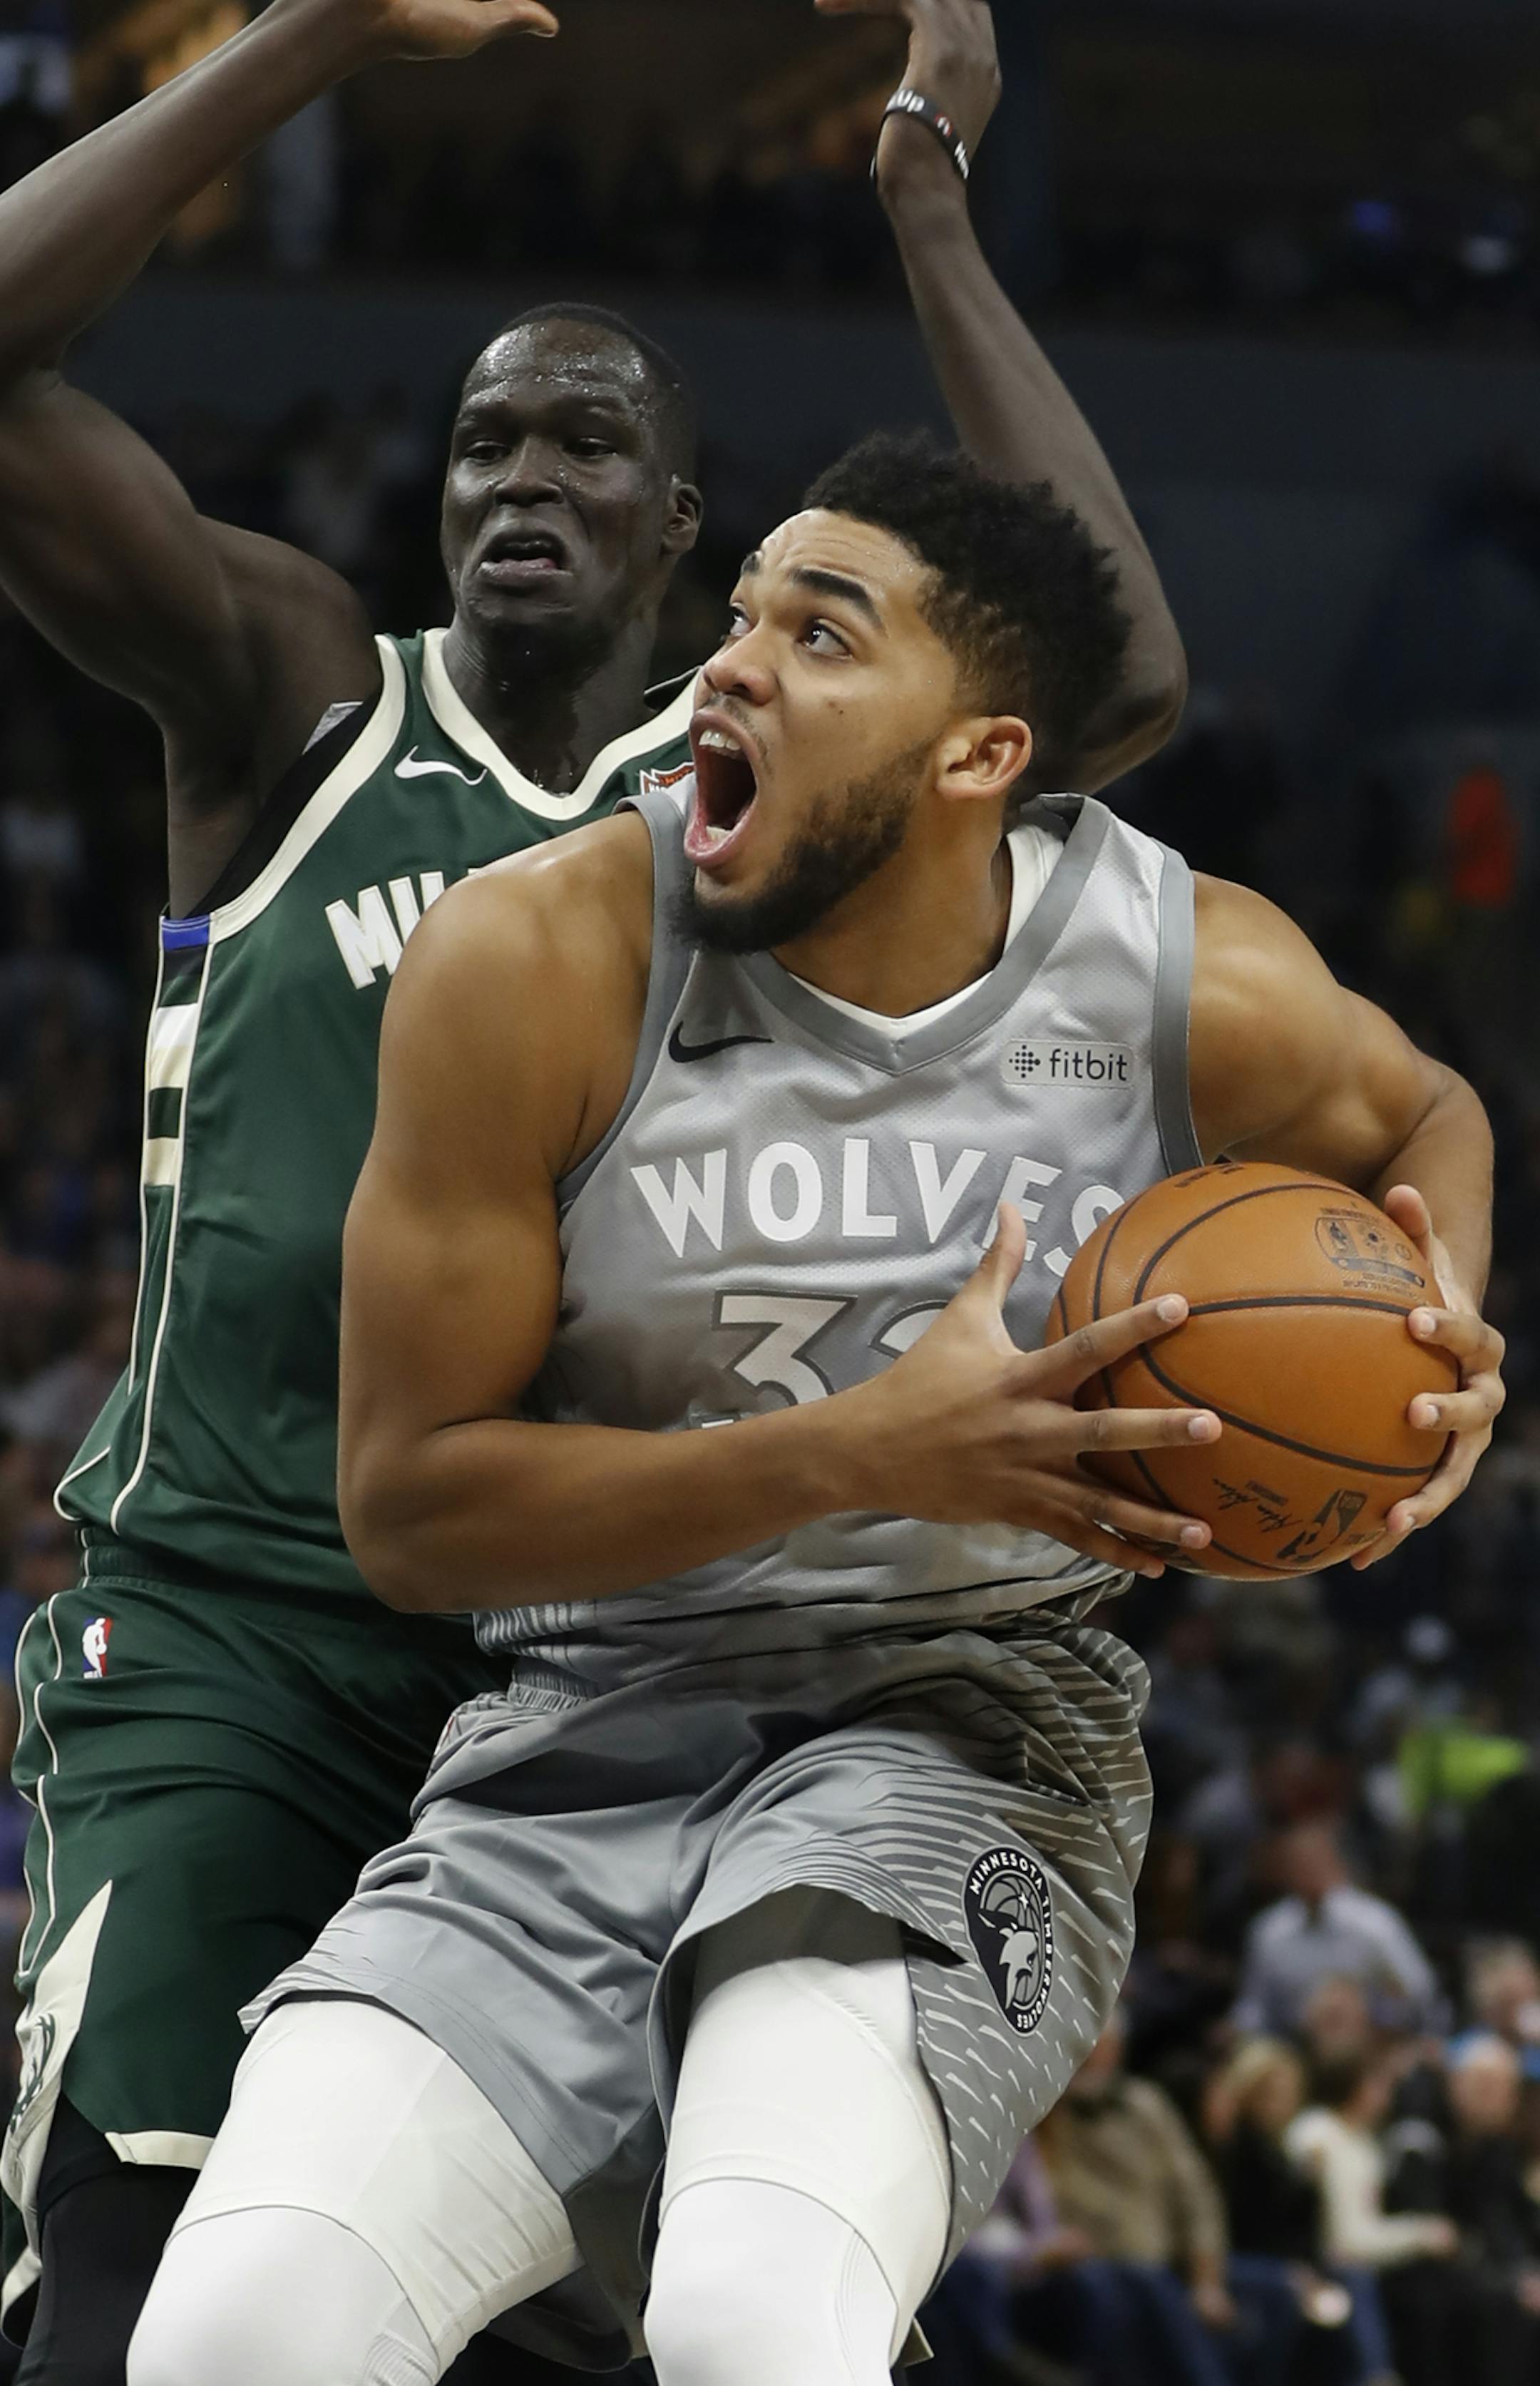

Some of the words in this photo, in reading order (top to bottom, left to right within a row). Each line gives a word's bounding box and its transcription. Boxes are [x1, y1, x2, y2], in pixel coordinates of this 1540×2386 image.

[1049, 1048, 1128, 1082] fitbit
[702, 1286, 952, 1429] 3
[969, 1851, 1044, 1895] MINNESOTA
[1016, 1895, 1053, 2029] TIMBERWOLVES
